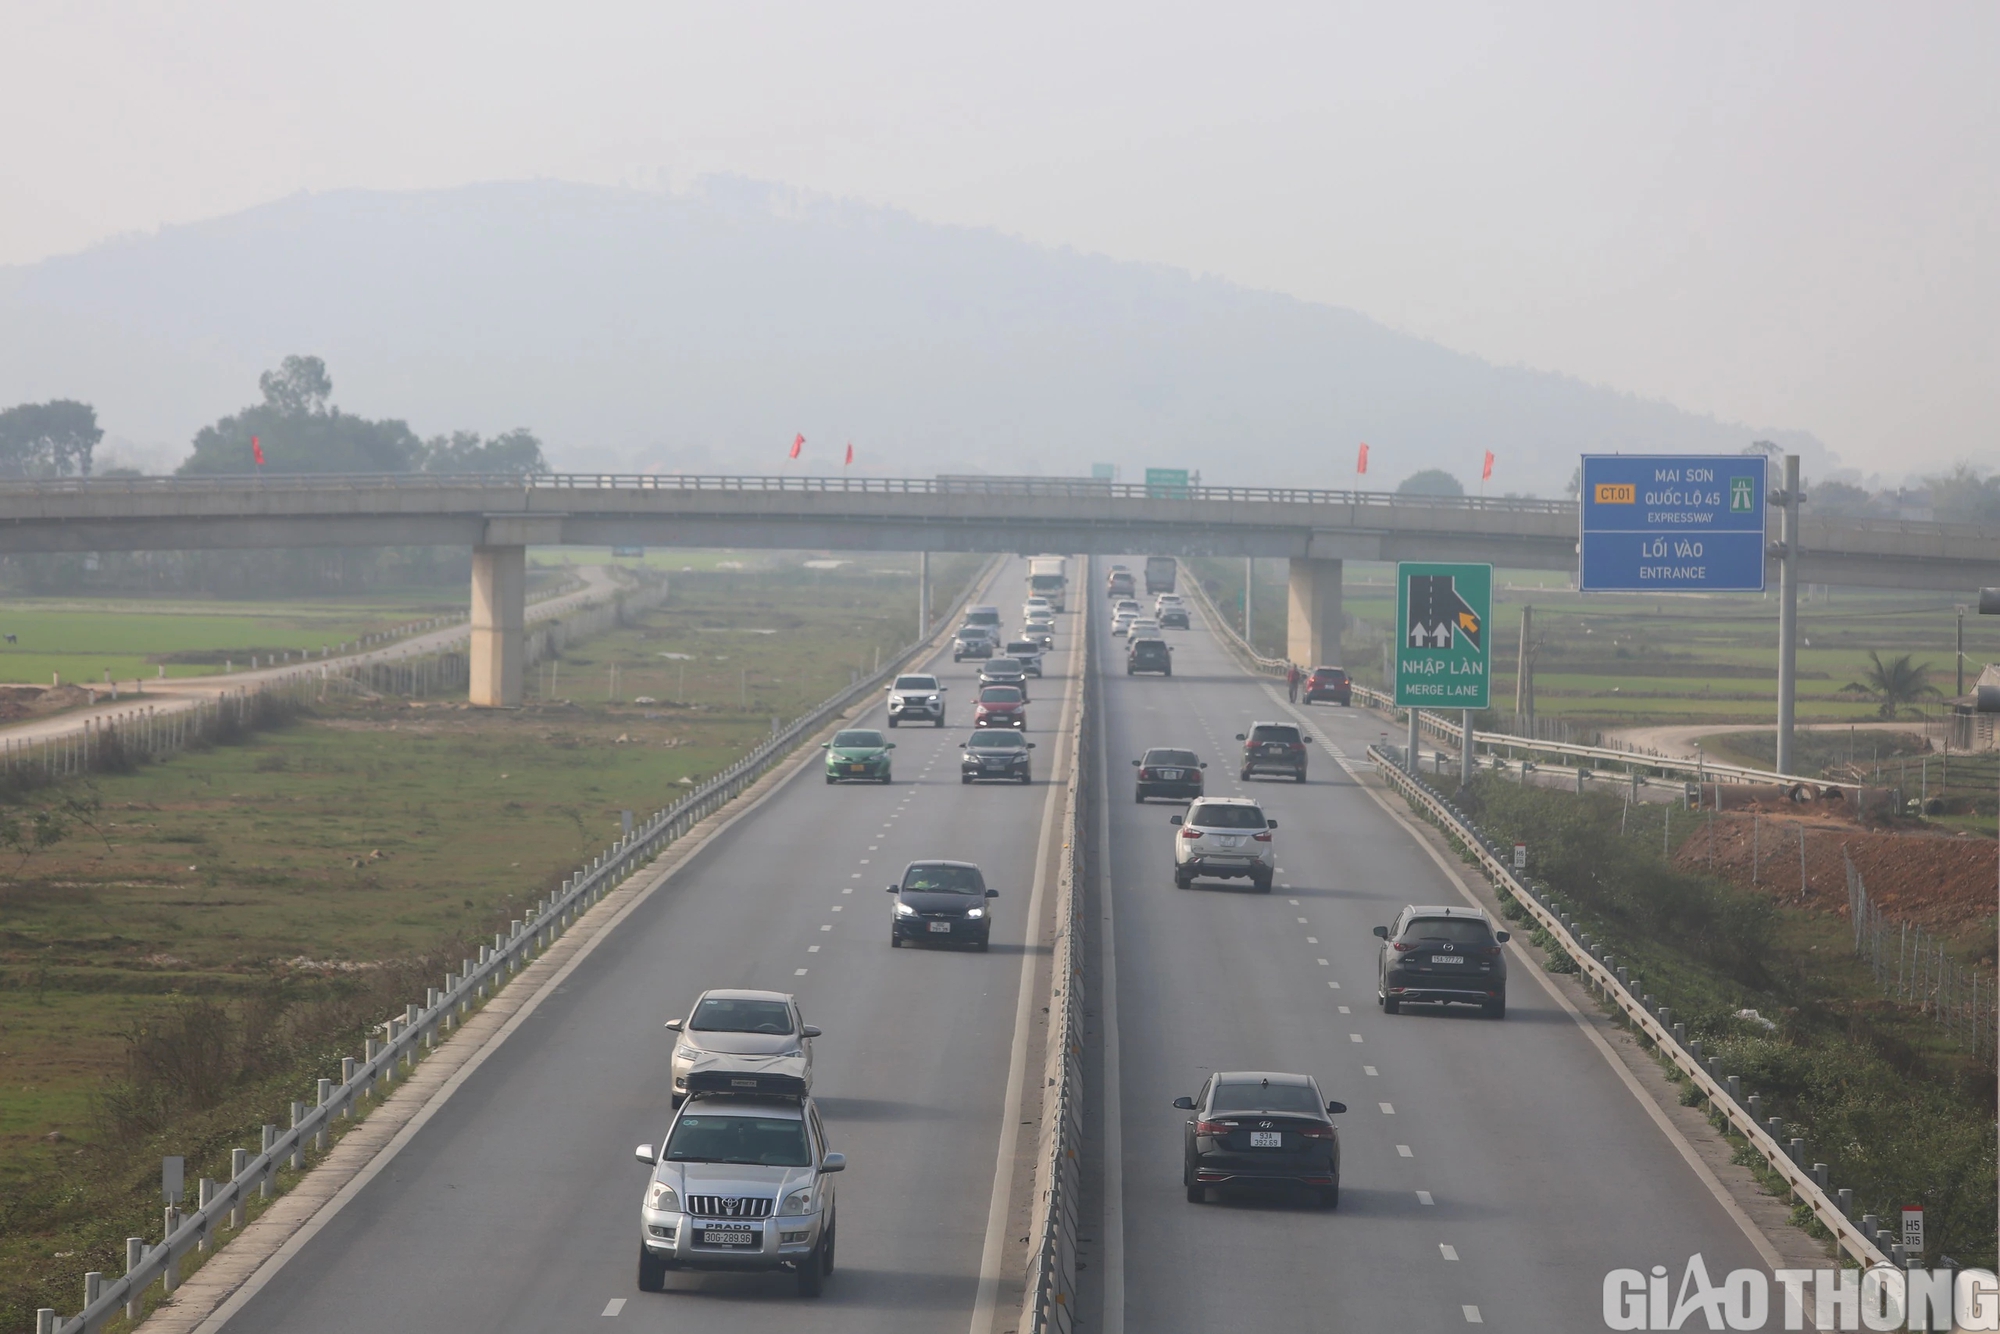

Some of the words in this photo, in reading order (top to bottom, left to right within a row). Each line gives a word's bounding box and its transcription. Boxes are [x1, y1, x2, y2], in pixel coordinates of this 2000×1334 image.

[1655, 469, 1680, 482] MAI
[1685, 468, 1714, 482] SƠN
[1600, 487, 1630, 500] CT.01
[1645, 487, 1682, 506] QUỐC
[1685, 491, 1701, 507] LỘ
[1705, 492, 1720, 505] 45
[1647, 512, 1714, 523] EXPRESSWAY
[1642, 536, 1668, 558] LỐI
[1674, 539, 1703, 558] VÀO
[1639, 566, 1706, 579] ENTRANCE
[1402, 657, 1445, 676] NHẬP
[1450, 657, 1483, 675] LÀN
[1406, 684, 1444, 695] MERGE
[1447, 685, 1478, 696] LANE
[1905, 1219, 1920, 1231] H5
[705, 1232, 751, 1243] 30G-289.96
[1905, 1236, 1920, 1245] 315
